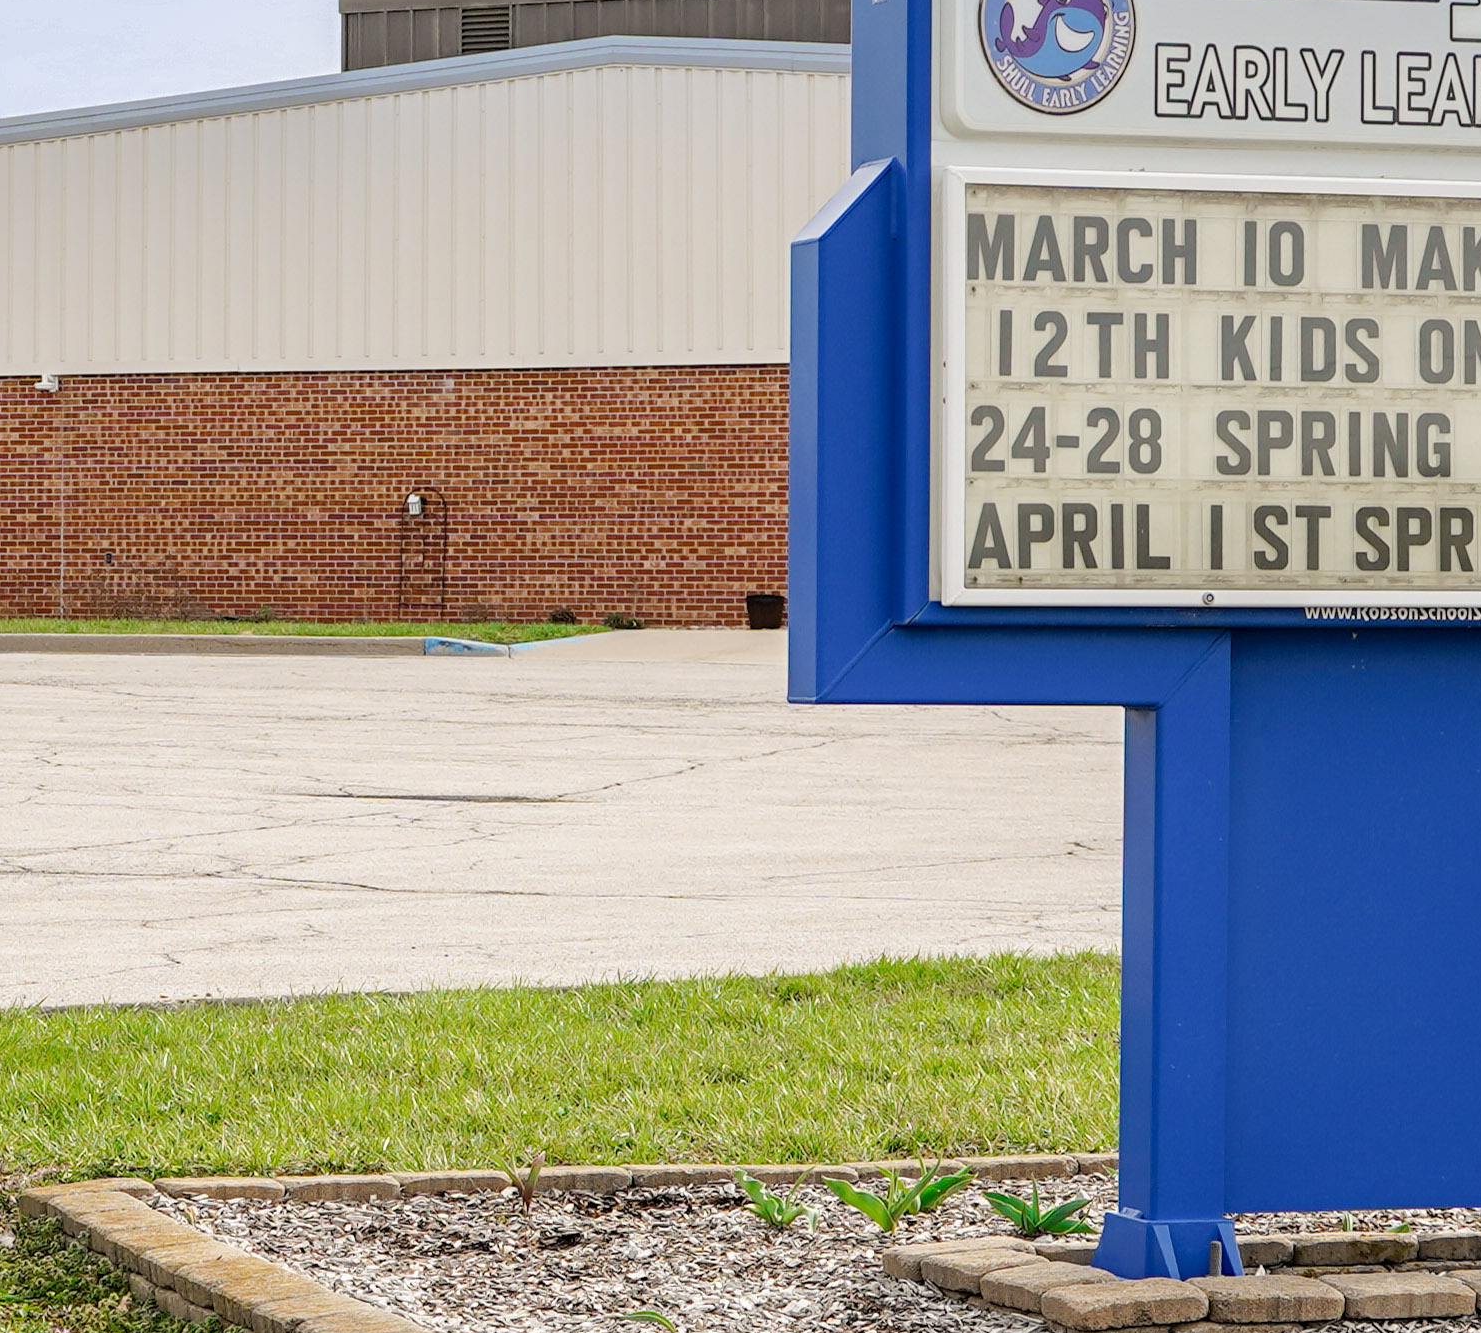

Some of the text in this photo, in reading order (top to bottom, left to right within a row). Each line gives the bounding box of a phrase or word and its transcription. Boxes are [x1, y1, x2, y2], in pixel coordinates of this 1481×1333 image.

[995, 11, 1131, 109] SHULL EARLY LEARNING
[1154, 42, 1345, 123] EARLY
[966, 213, 1197, 284] MARCH
[1244, 220, 1305, 287] 10
[999, 310, 1169, 379] 12TH
[1221, 315, 1380, 383] KIDS
[970, 405, 1162, 474] 24-28
[1216, 410, 1451, 478] SPRING
[967, 502, 1171, 570] APRIL
